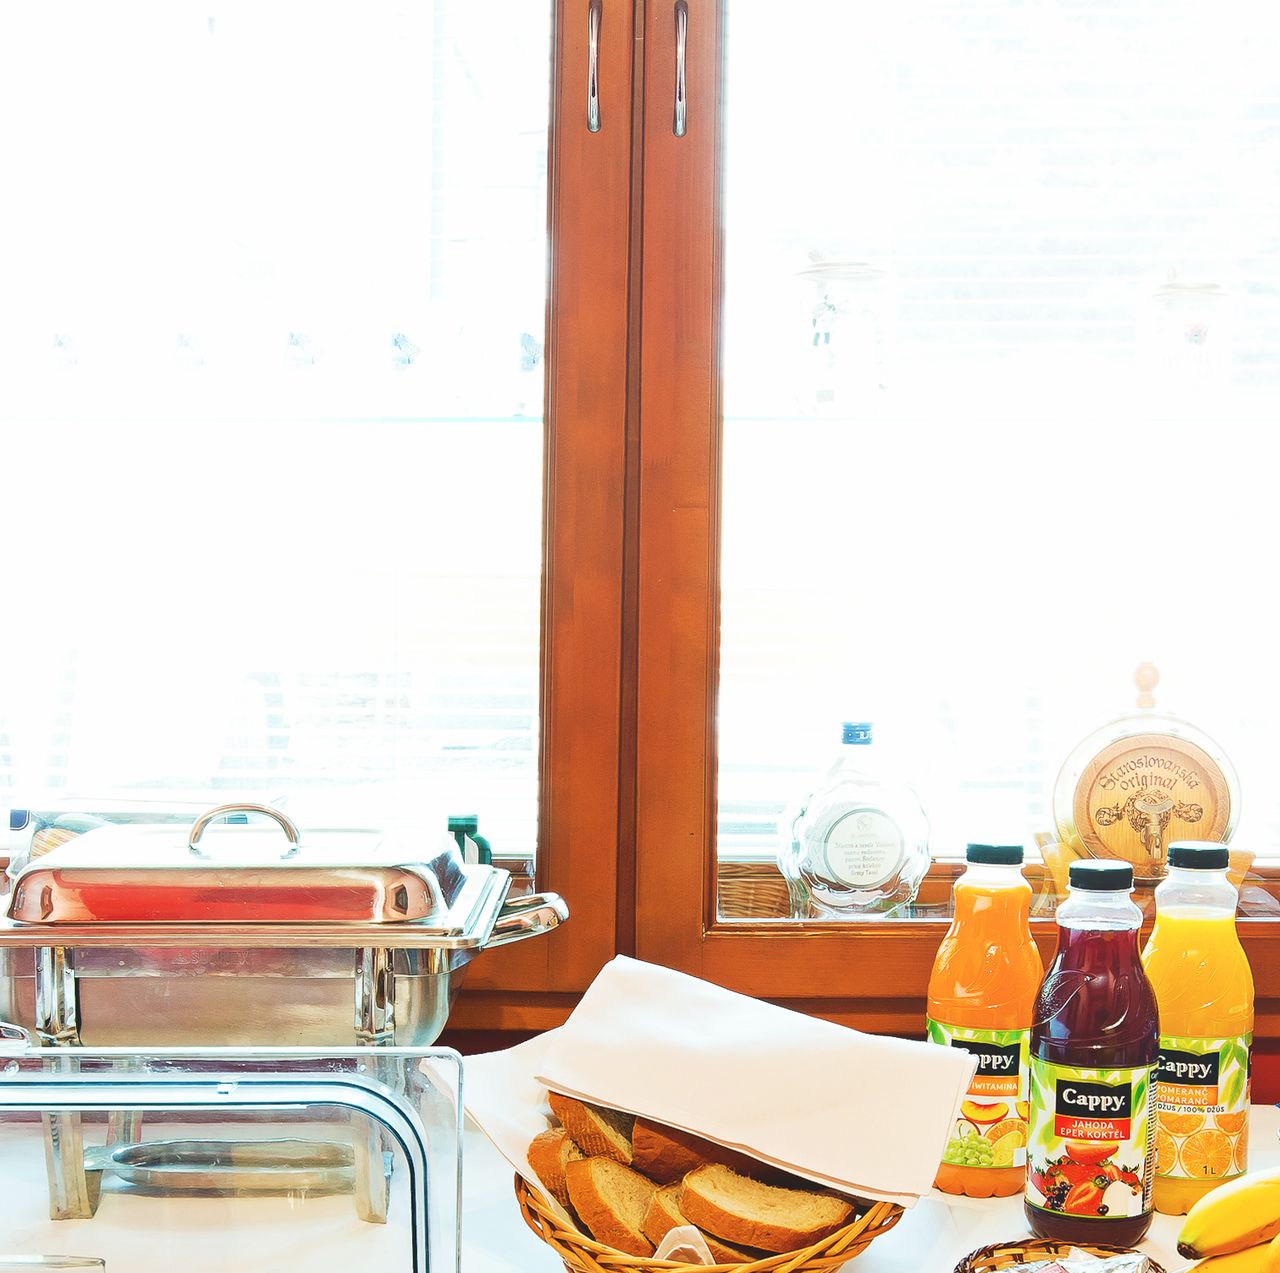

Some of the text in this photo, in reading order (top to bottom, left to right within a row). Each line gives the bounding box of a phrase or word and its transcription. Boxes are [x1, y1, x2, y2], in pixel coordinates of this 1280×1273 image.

[1119, 771, 1178, 791] original
[979, 1053, 1013, 1070] ppy
[1157, 1055, 1212, 1079] Cappy
[1062, 1088, 1125, 1111] Cappy
[1157, 1095, 1208, 1105] OMARANČ
[1072, 1120, 1114, 1129] JAHODA
[1060, 1127, 1084, 1138] EPER
[1202, 1165, 1209, 1175] 1
